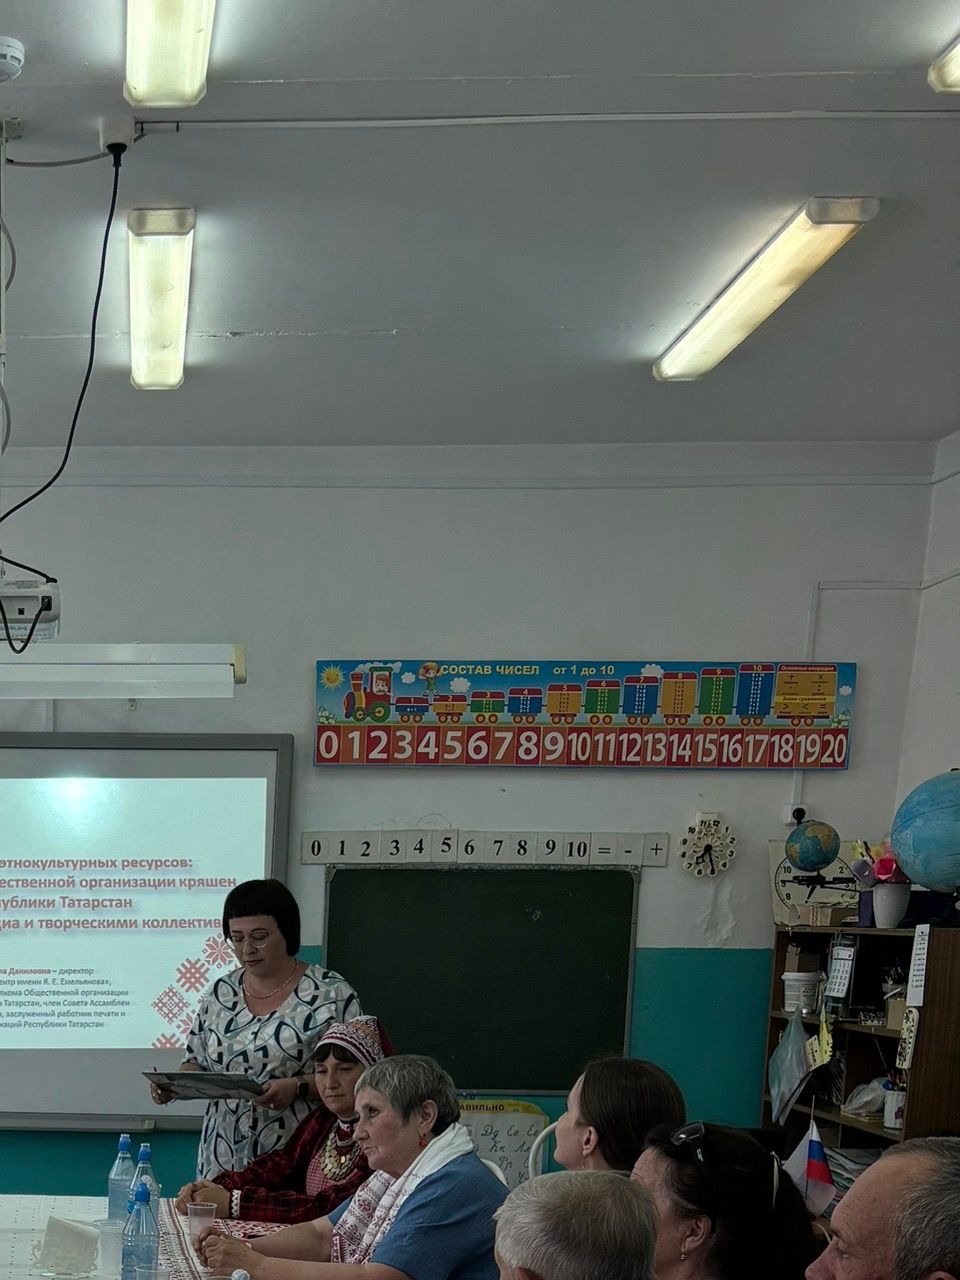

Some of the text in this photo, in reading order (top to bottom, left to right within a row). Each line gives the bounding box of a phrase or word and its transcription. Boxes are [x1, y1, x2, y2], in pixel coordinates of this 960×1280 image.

[440, 664, 615, 676] СОСТАВ ЧИСЕЛ от 1 до 10
[319, 730, 847, 762] 0 1 2 3 4 5 6 7 8 9 10 11 12 13 14 15 16 17 18 19 20
[311, 837, 587, 857] 0 1 2 3 4 5 6 7 8 9 10
[0, 858, 117, 871] этнокультурных
[121, 858, 193, 870] ресурсов:
[79, 877, 176, 890] организации
[179, 877, 236, 890] кряшен
[59, 896, 133, 911] Татарстан
[24, 919, 33, 929] и
[38, 919, 138, 931] творческими
[143, 918, 222, 929] коллектив
[8, 968, 51, 976] Даниловна
[58, 968, 94, 976] директор
[24, 989, 79, 997] Общественной
[4, 1000, 41, 1008] Татарстан,
[6, 1010, 55, 1018] заслуженный
[57, 1010, 92, 1018] работник
[24, 1020, 67, 1029] Республики
[68, 1021, 104, 1029] Татарстан
